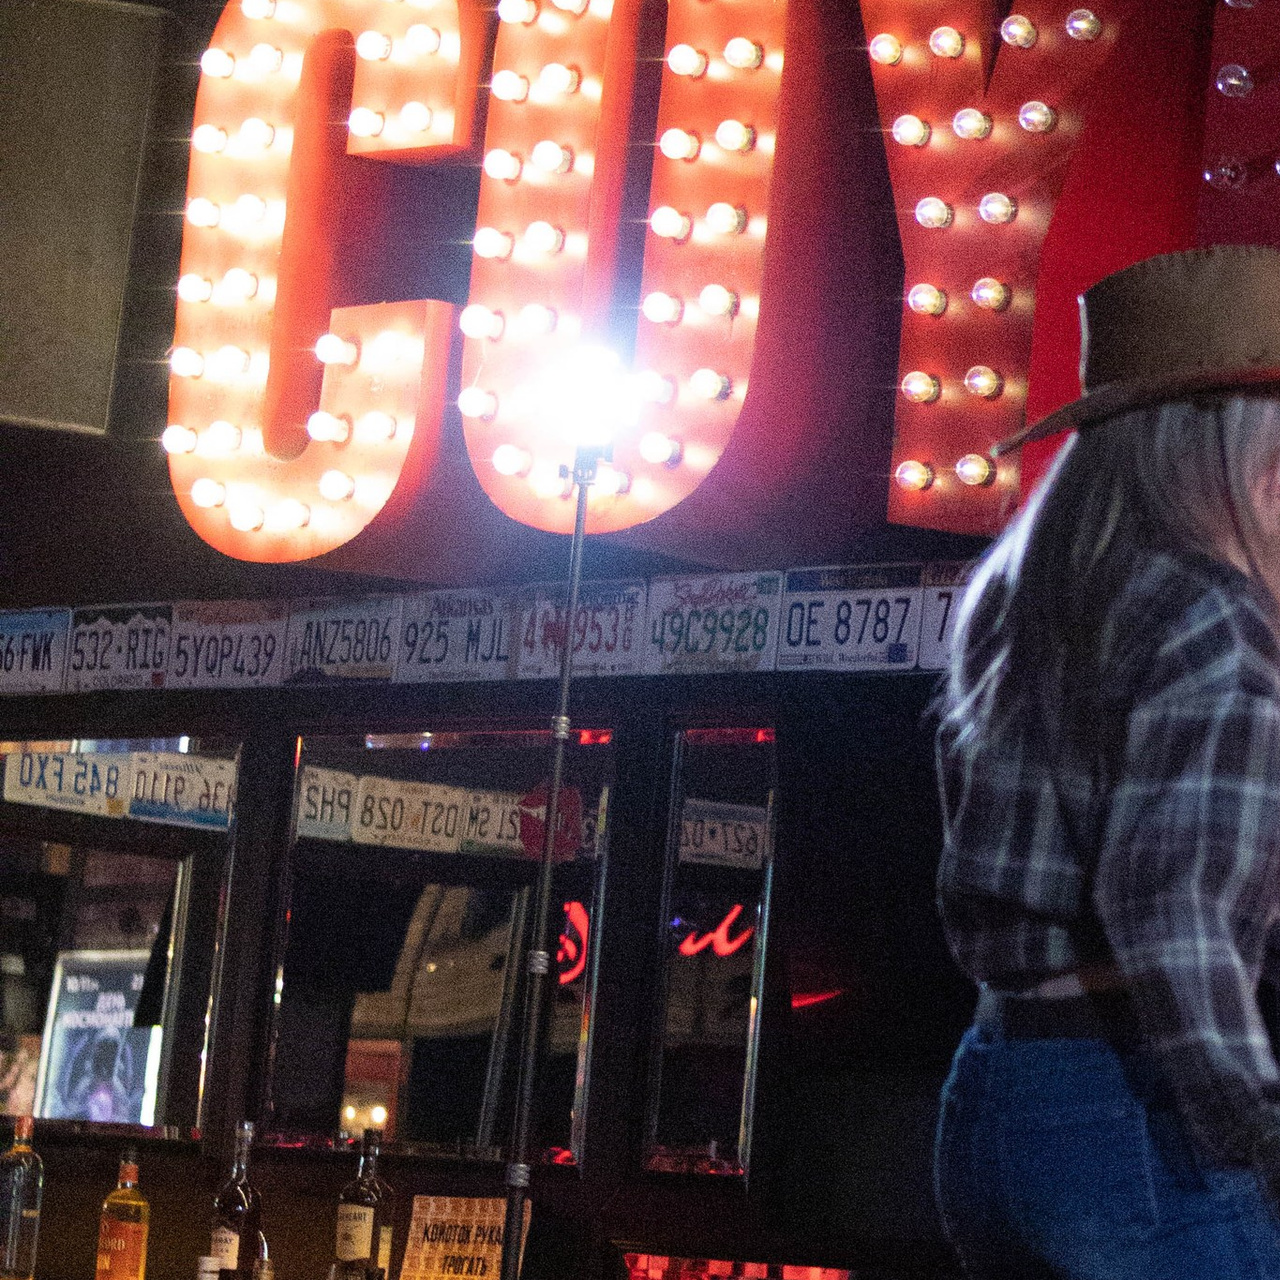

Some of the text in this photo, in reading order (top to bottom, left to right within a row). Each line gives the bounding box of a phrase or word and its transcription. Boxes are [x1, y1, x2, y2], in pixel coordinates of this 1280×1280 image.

[834, 598, 911, 645] 8787
[403, 618, 509, 664] 925 MJL
[474, 1224, 504, 1245] РУКА
[441, 1254, 488, 1276] ТРОГАТЬ
